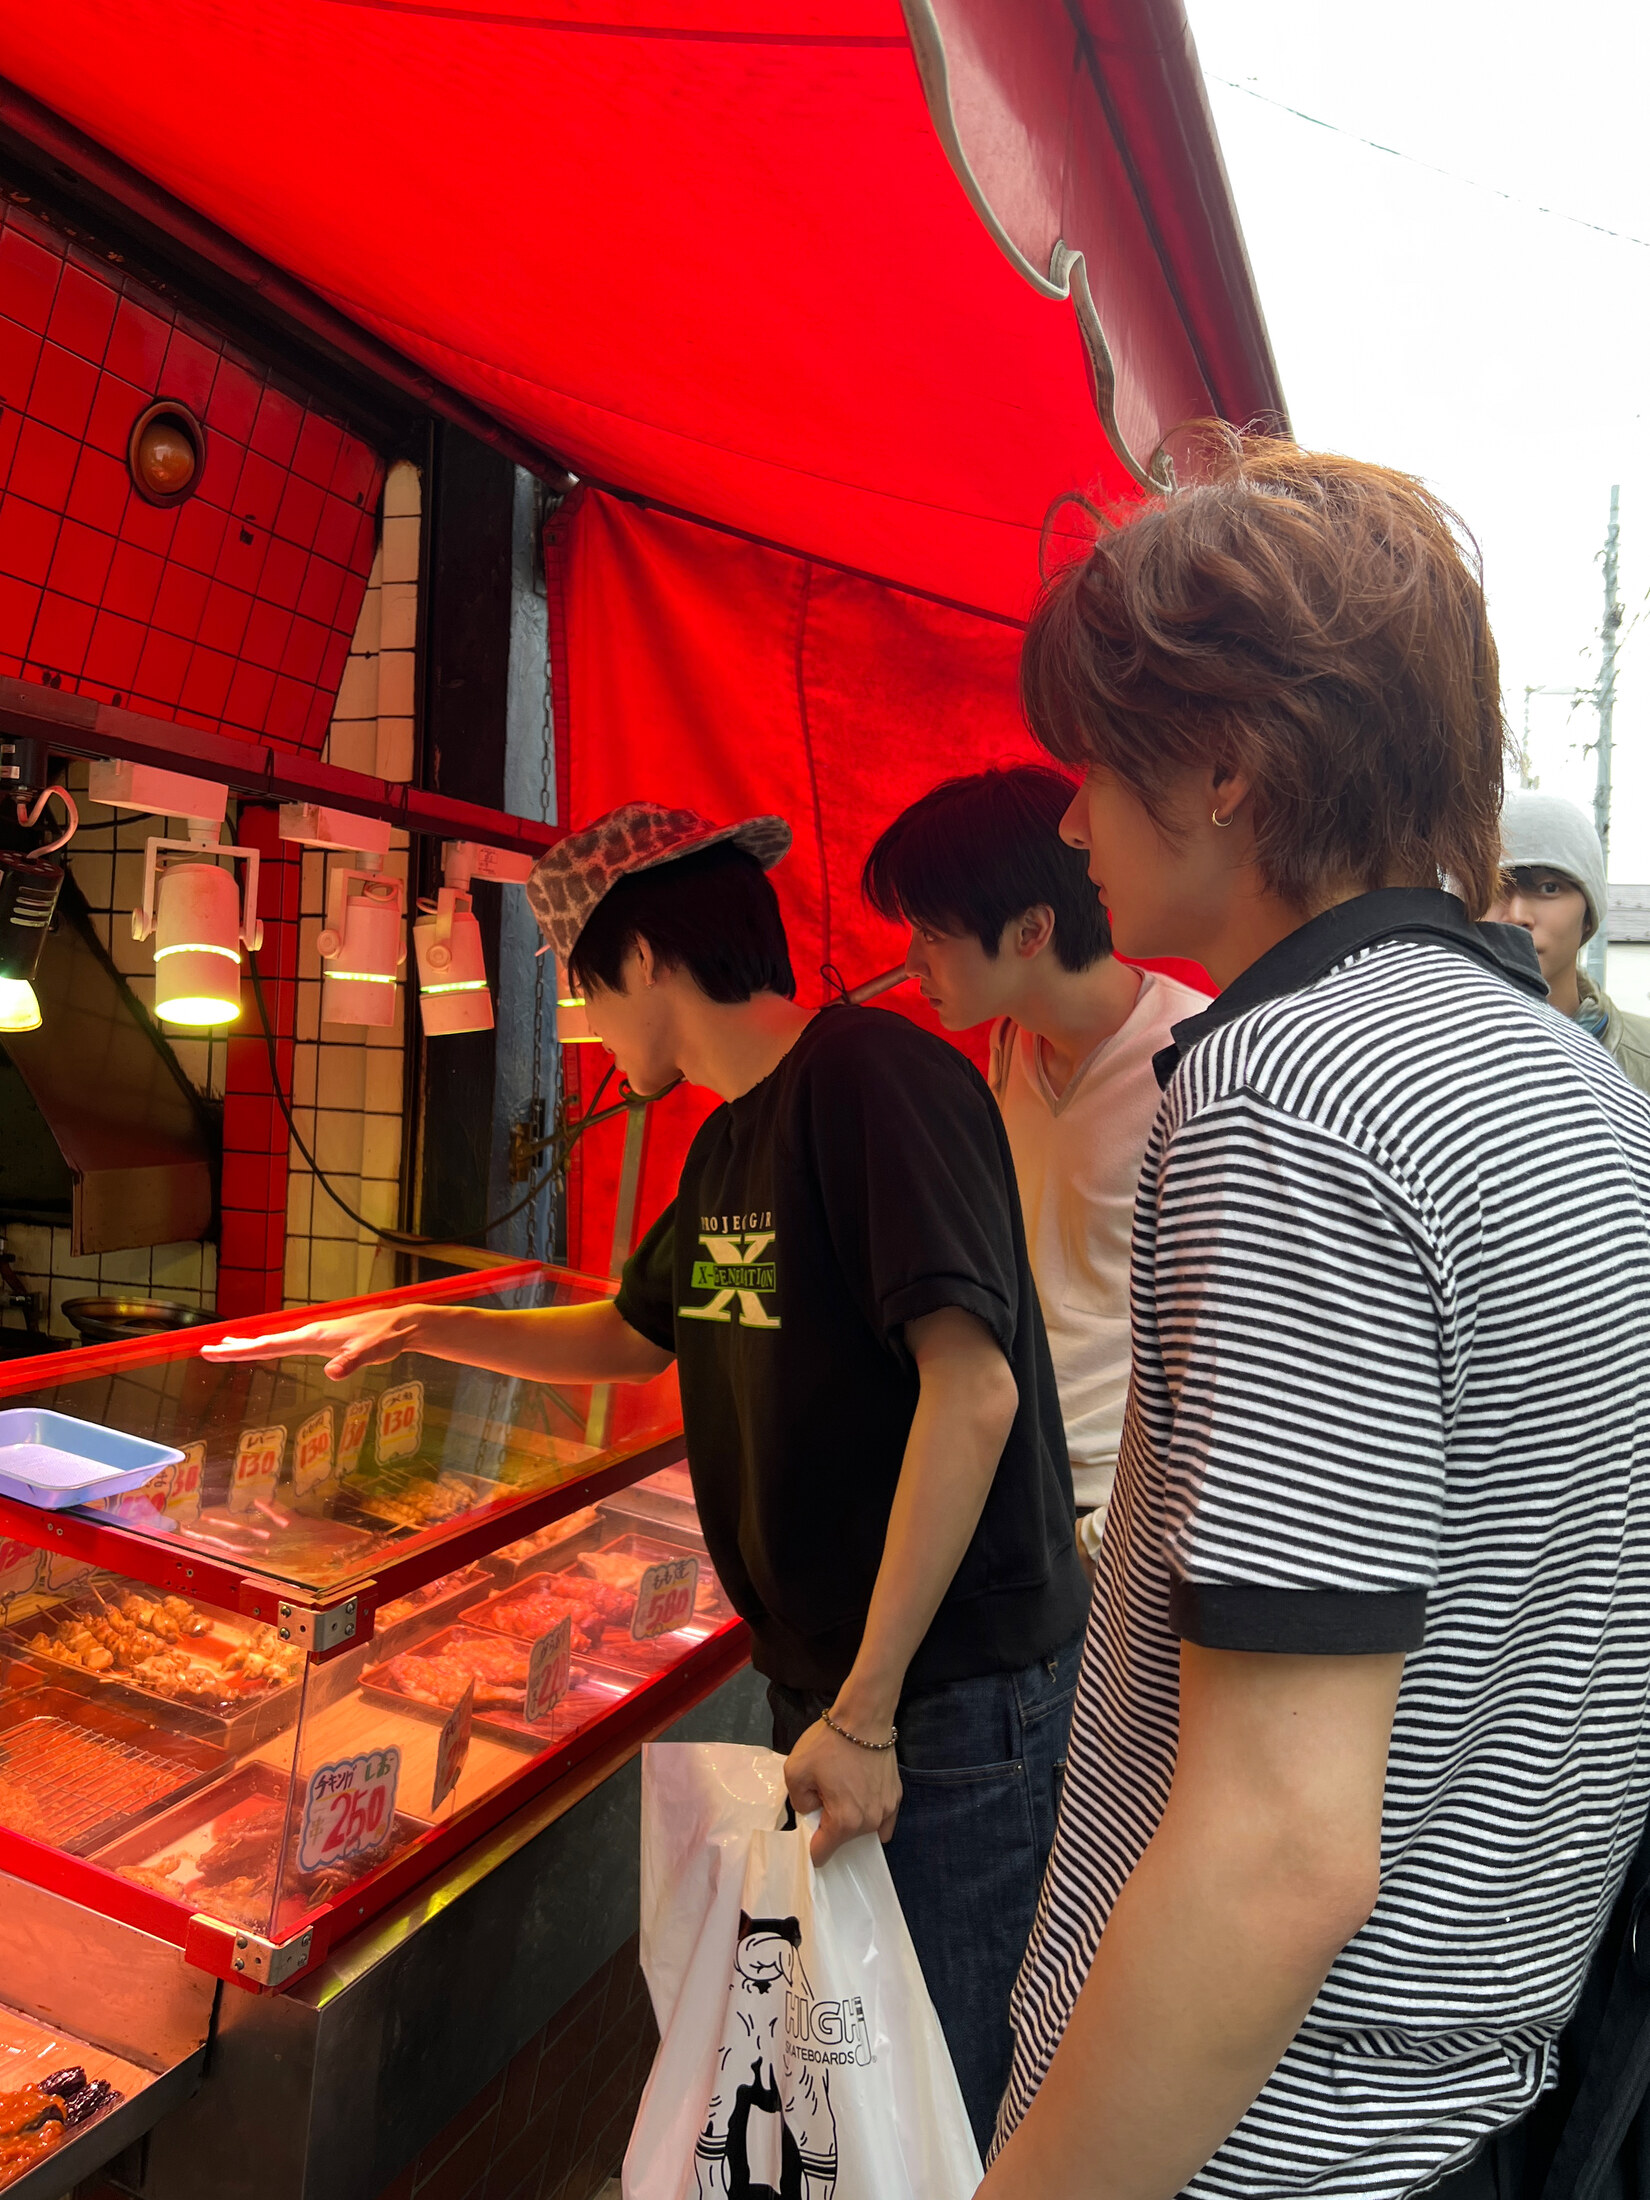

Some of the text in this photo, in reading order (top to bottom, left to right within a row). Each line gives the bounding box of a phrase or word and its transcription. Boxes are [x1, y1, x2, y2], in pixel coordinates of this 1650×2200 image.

[383, 1405, 416, 1437] 130
[238, 1450, 276, 1480] 130
[300, 1432, 330, 1469] 130
[172, 1465, 200, 1497] 30
[321, 1784, 386, 1854] 250
